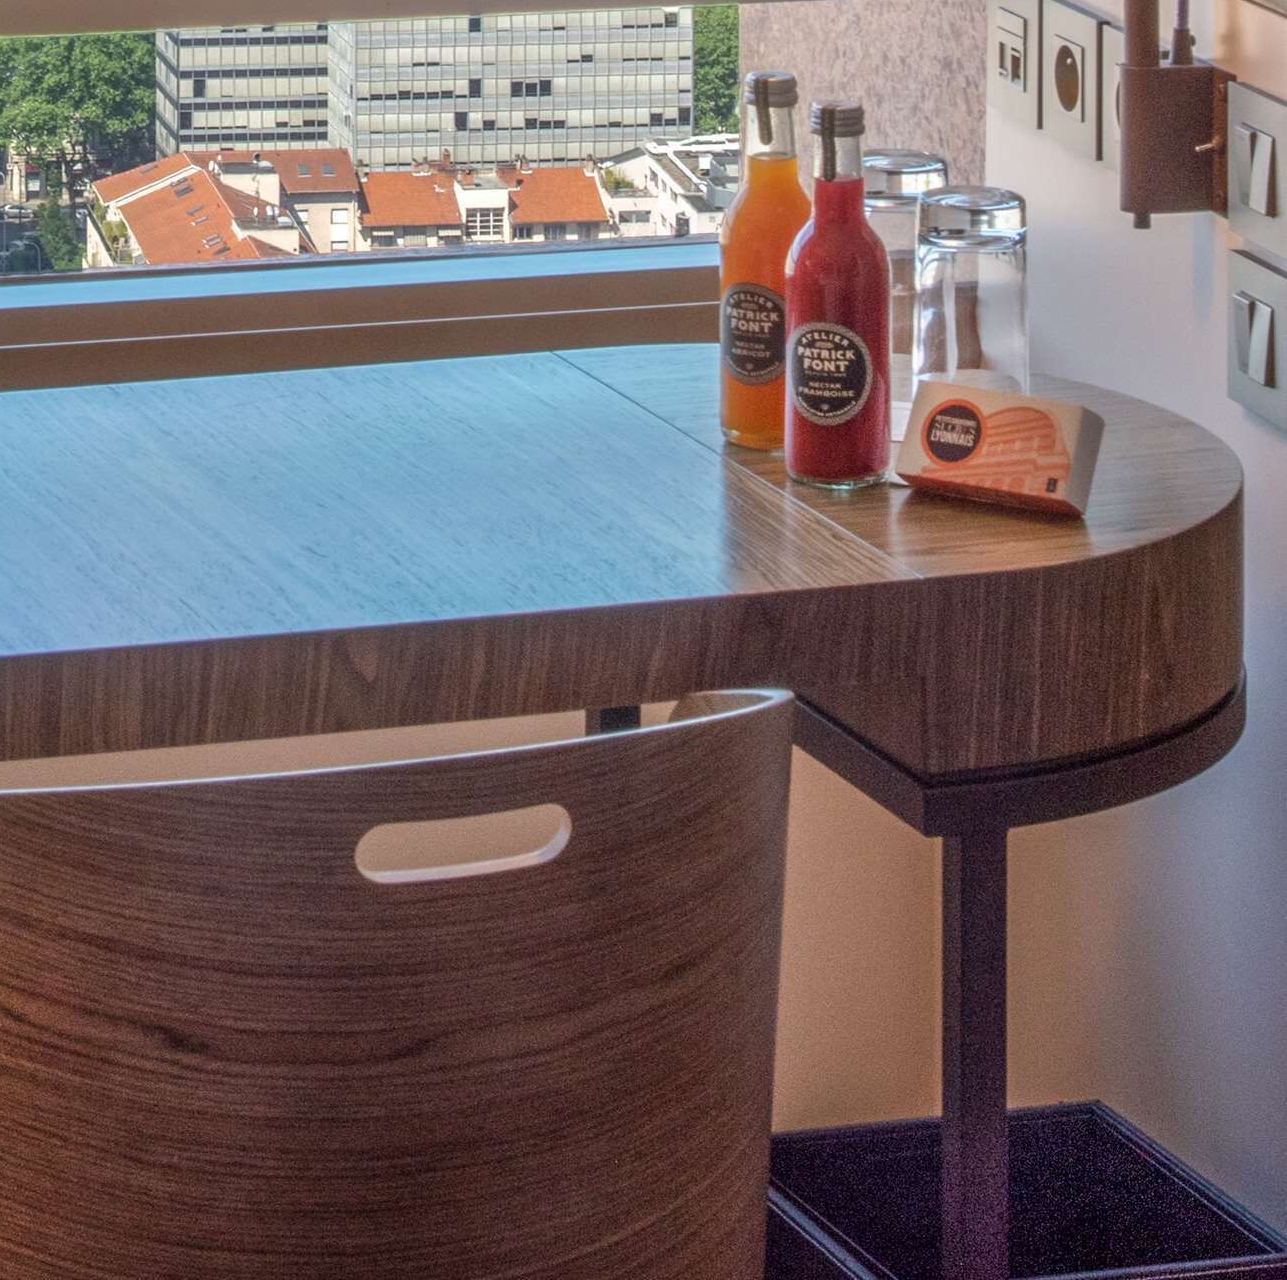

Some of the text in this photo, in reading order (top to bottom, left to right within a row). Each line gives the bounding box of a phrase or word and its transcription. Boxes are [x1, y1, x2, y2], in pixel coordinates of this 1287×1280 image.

[729, 293, 774, 309] ATELIER
[725, 305, 780, 322] PATRICK
[730, 318, 773, 333] FONT
[801, 332, 850, 347] ATELIER
[797, 346, 856, 360] PATRICK
[802, 358, 850, 372] FONT
[930, 429, 976, 447] LYONNAIS
